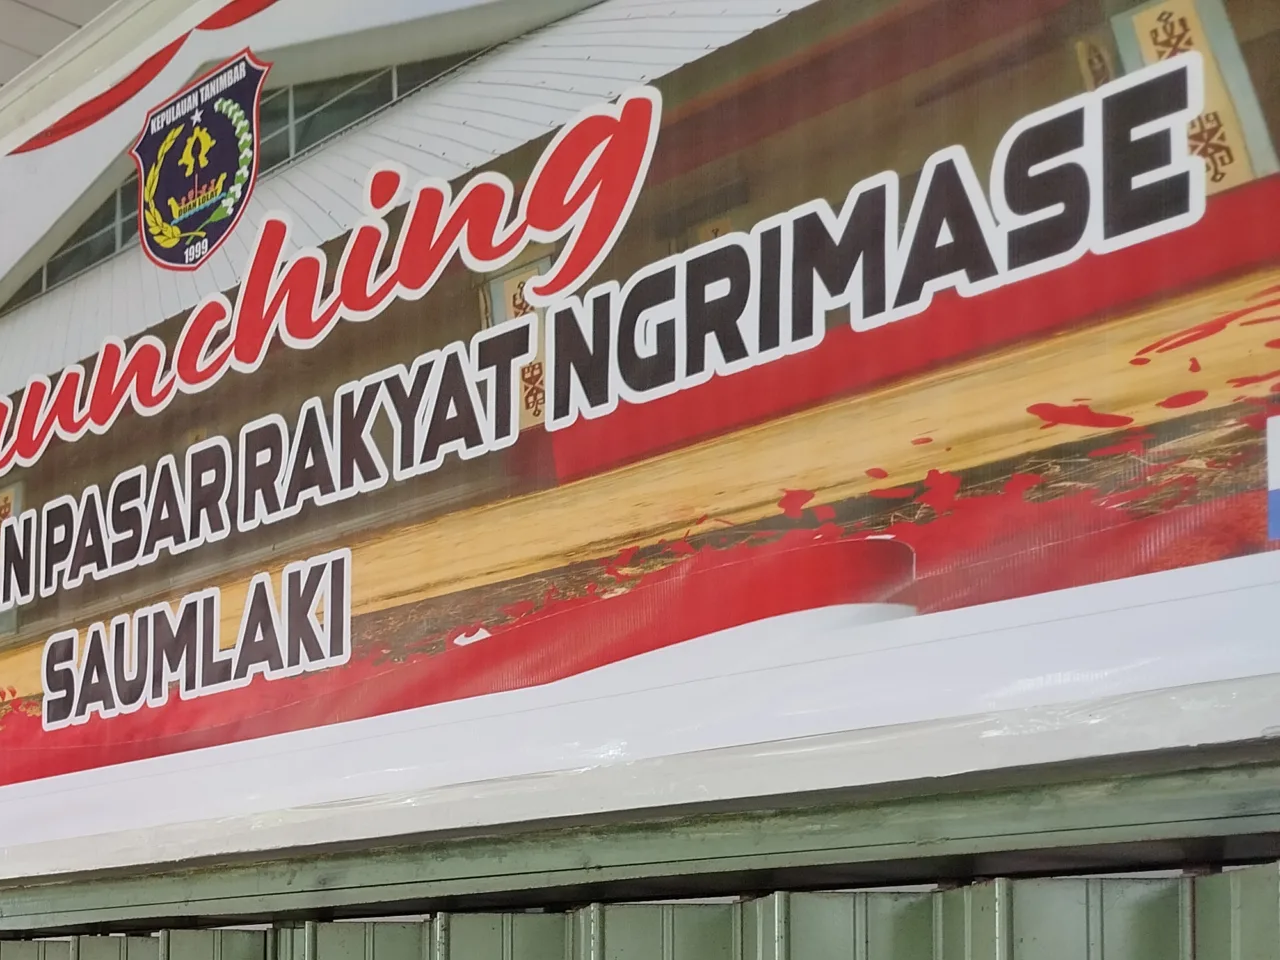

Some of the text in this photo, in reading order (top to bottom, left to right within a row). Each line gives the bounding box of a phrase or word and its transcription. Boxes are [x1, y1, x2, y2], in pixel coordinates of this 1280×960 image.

[150, 61, 247, 135] KEPULAUAN TANIMBAR
[183, 239, 208, 264] 1999
[46, 445, 226, 591] PASAR
[242, 323, 531, 525] RAKYAT
[552, 62, 1195, 423] NGRIMASE
[45, 552, 350, 727] SAUMLAKI
